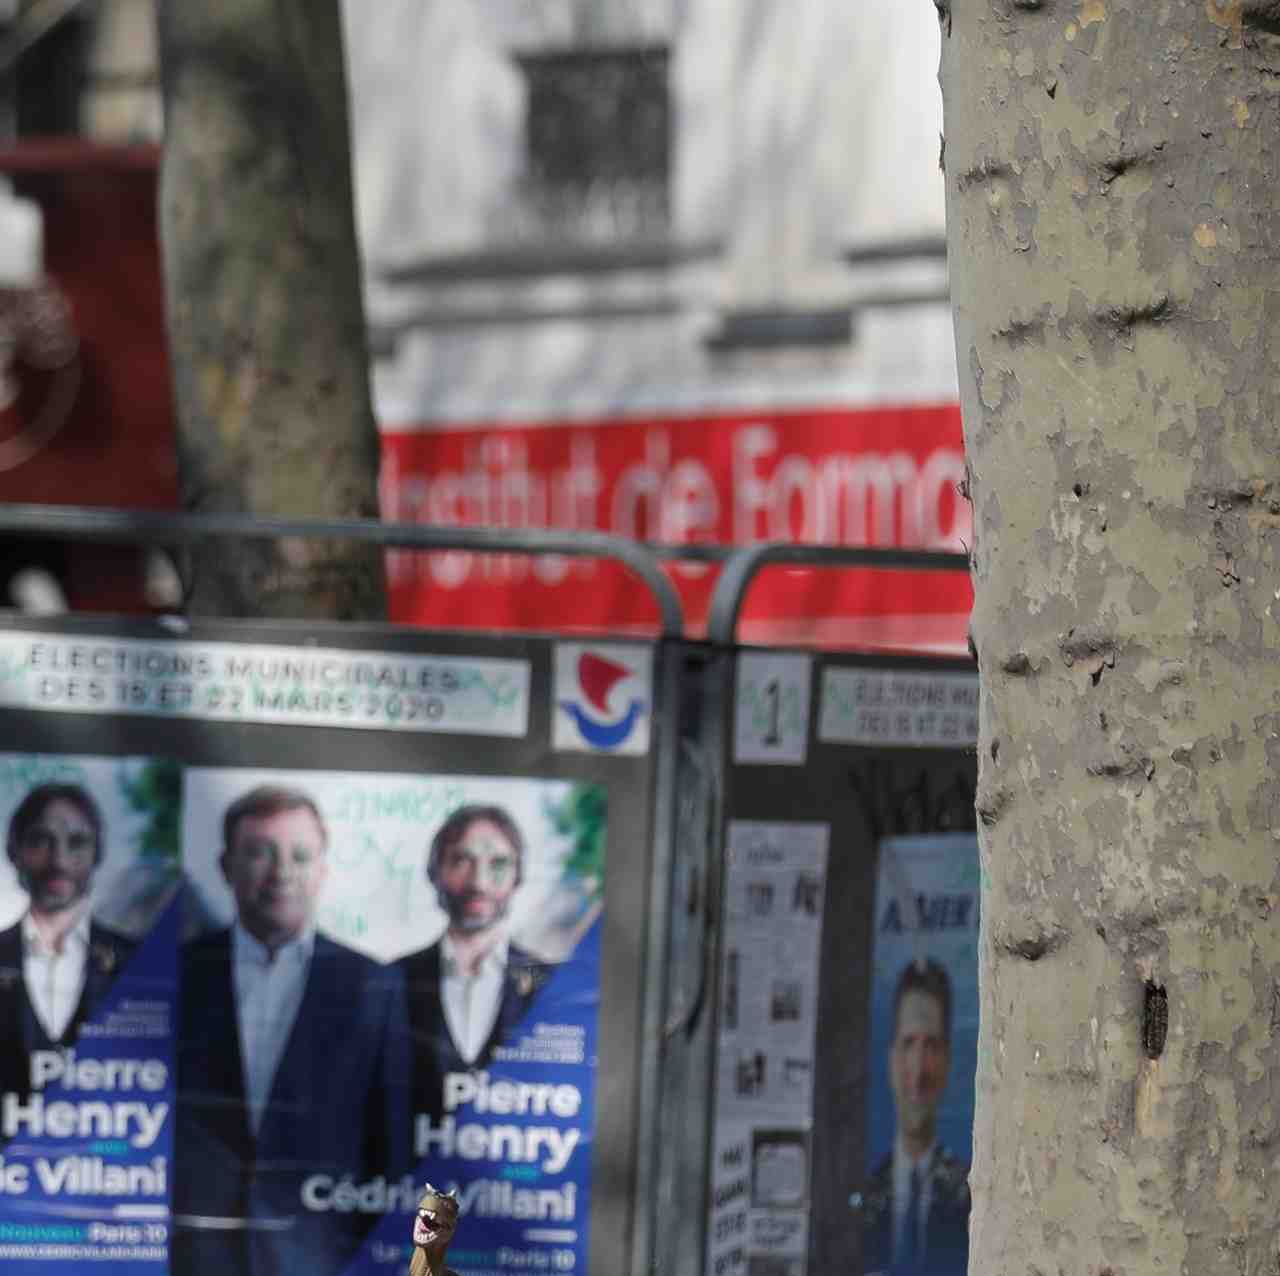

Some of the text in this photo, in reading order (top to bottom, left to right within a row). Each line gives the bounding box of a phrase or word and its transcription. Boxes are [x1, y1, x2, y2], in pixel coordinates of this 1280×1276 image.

[613, 430, 720, 572] de
[40, 678, 100, 702] DES
[252, 688, 353, 716] MARS
[762, 680, 781, 747] 1
[31, 1046, 168, 1091] Pierre
[443, 1068, 582, 1118] Pierre
[2, 1091, 170, 1149] Henry
[412, 1111, 581, 1175] Henry
[34, 1154, 168, 1195] Villani
[145, 1222, 169, 1244] 10
